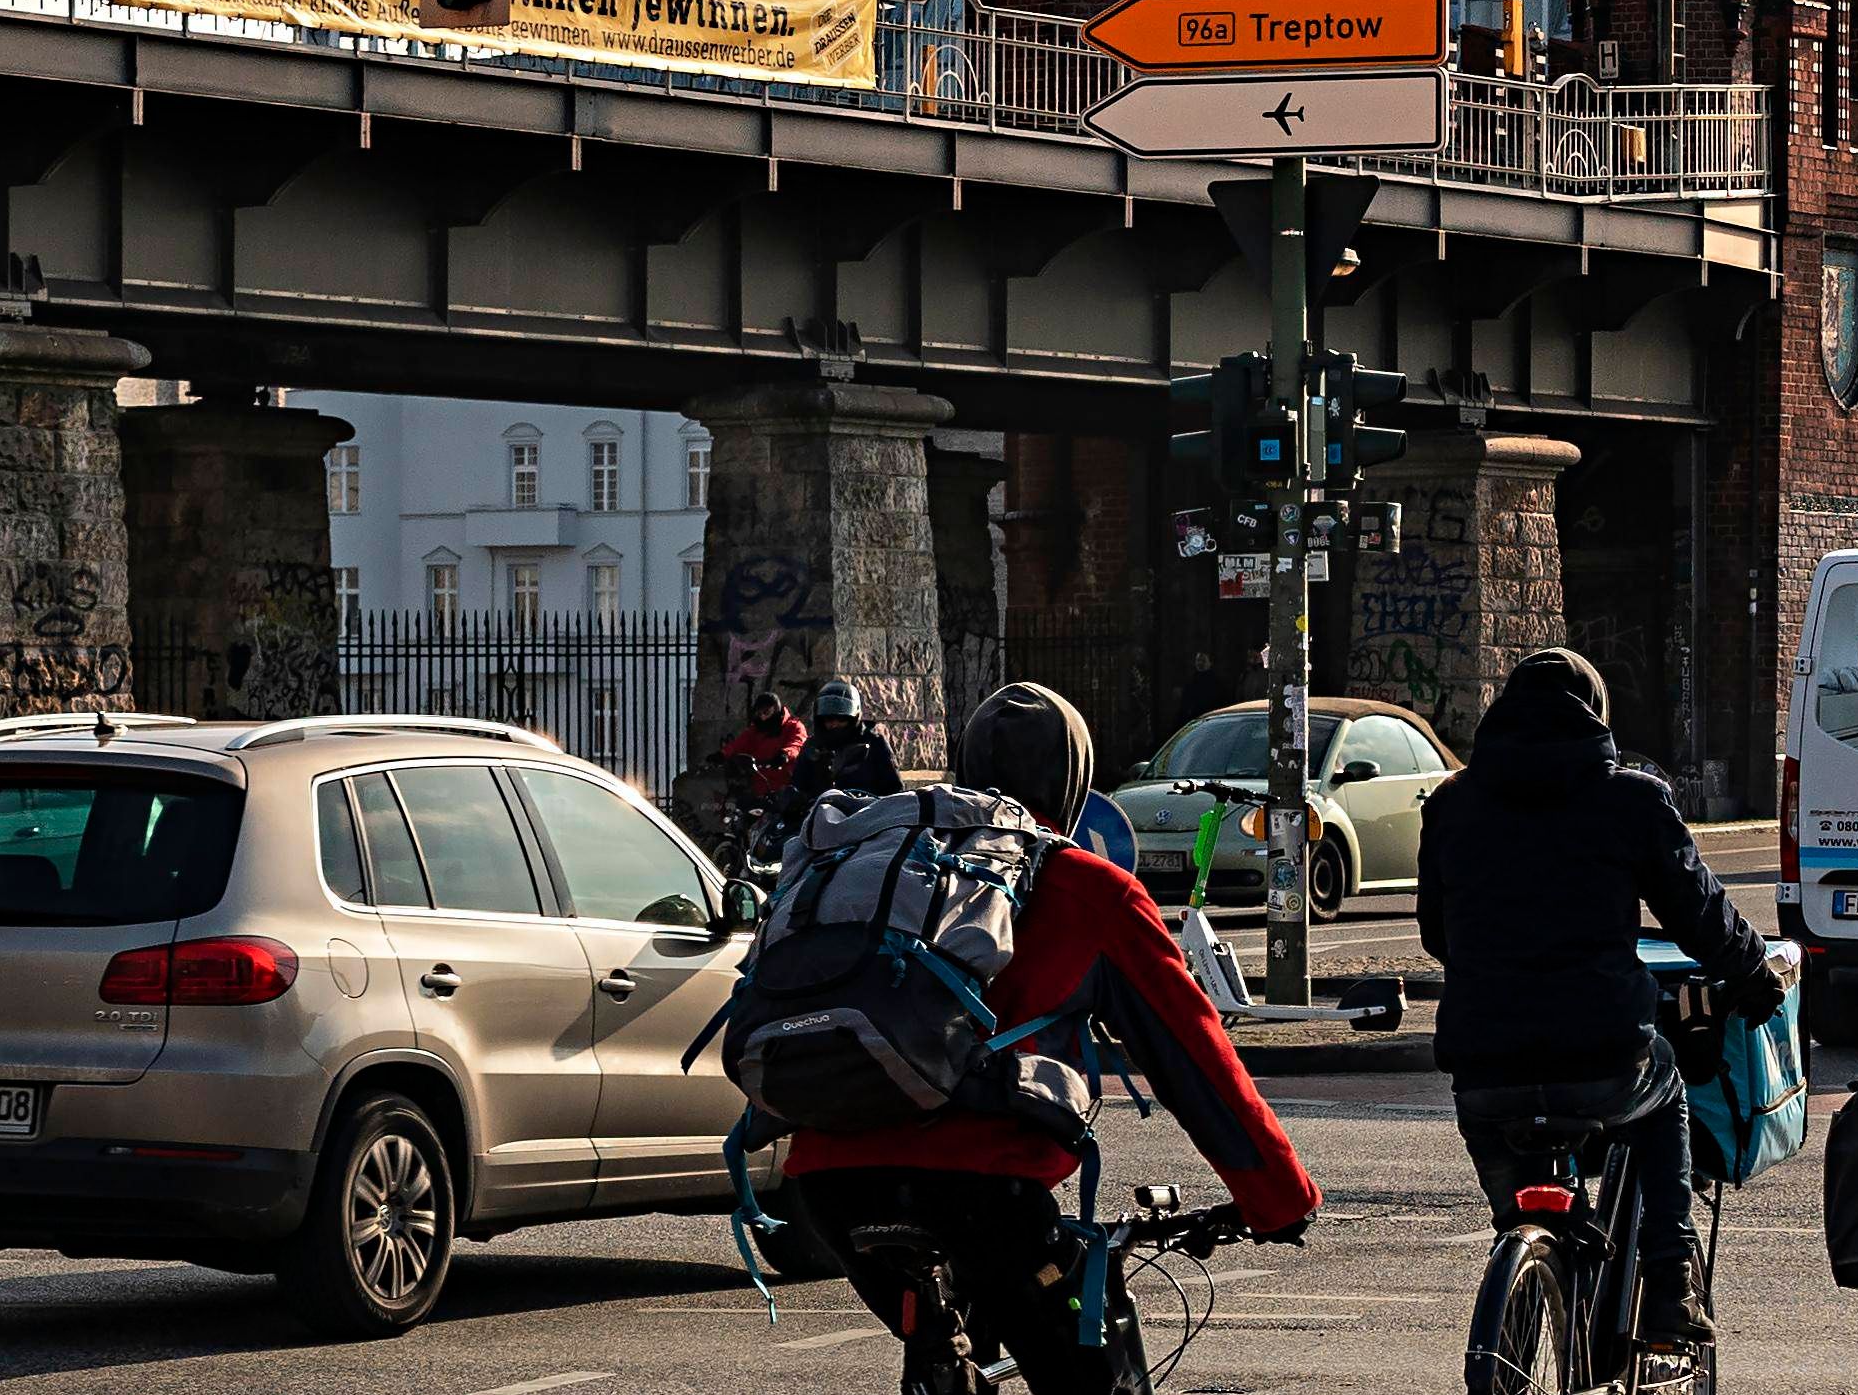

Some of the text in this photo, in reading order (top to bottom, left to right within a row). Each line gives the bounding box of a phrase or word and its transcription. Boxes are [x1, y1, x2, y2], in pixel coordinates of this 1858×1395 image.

[511, 20, 593, 47] gewinnen.
[602, 29, 795, 69] www.draussenwerber.de
[814, 12, 856, 55] DRAUSSEN
[1185, 13, 1383, 48] 96a Treptow
[94, 1009, 158, 1022] 2.0 TDI
